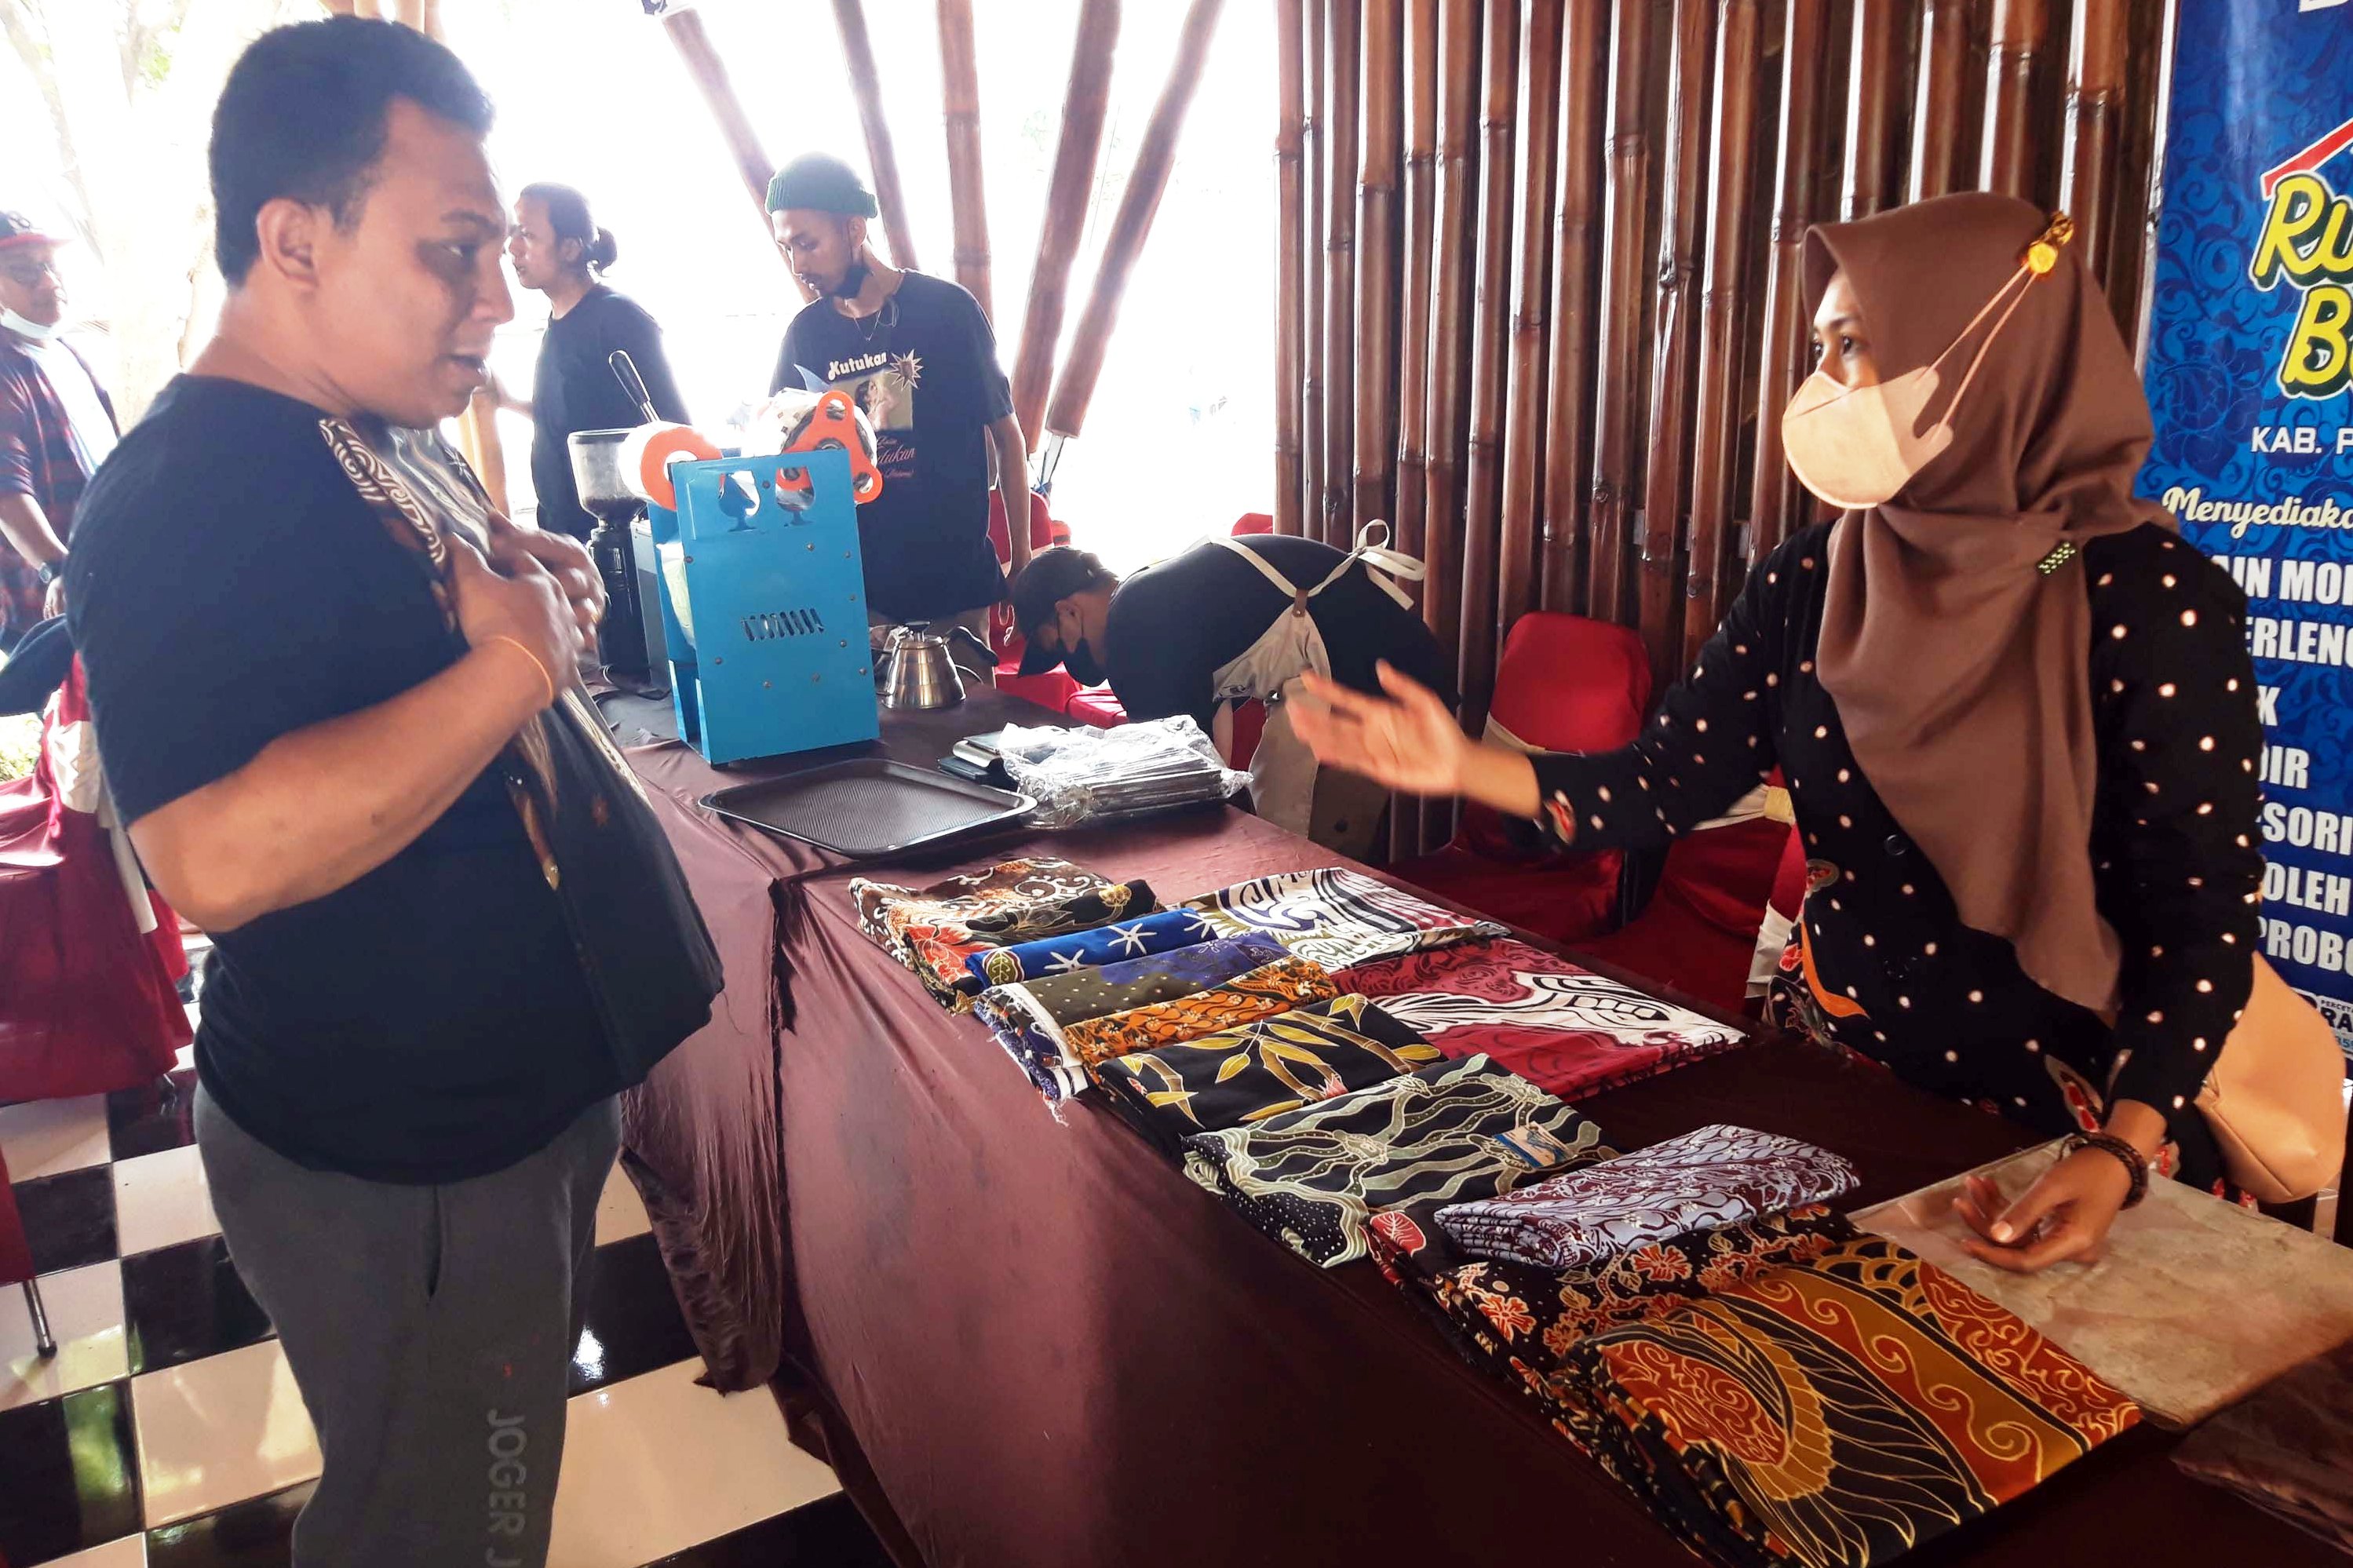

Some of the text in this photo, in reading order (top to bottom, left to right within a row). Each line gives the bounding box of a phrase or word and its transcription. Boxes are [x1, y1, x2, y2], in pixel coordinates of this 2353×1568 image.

[828, 352, 888, 381] Kutukan
[2251, 426, 2322, 454] KAB.
[2264, 862, 2351, 917] OLEH
[487, 1409, 527, 1536] JOGER
